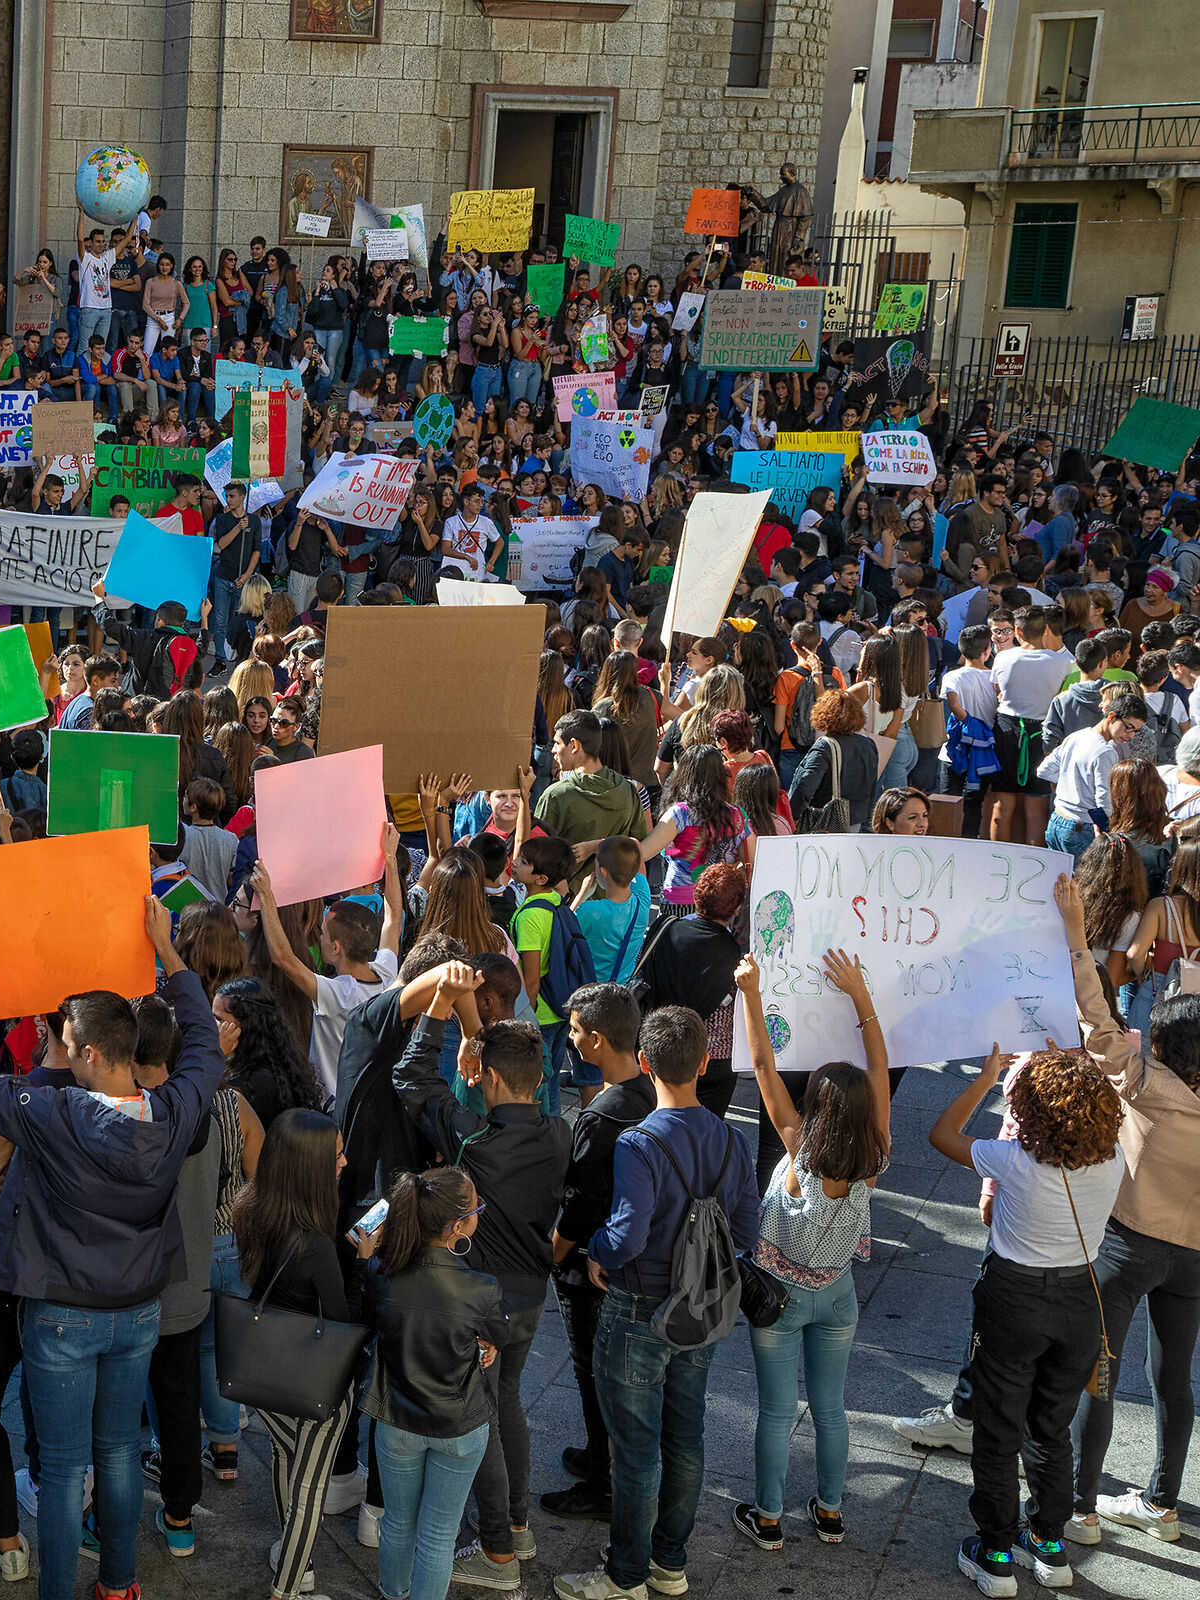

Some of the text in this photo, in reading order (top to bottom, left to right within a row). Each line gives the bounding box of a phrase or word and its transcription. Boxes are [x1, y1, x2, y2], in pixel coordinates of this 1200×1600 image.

[788, 291, 818, 302] MENTE
[827, 291, 846, 306] the
[787, 304, 818, 315] GENTE
[726, 318, 751, 328] NON
[707, 331, 799, 347] SPUDORATAMENTE
[705, 349, 793, 365] INDIFFERENTE
[857, 355, 887, 387] ACT
[22, 392, 36, 412] A
[597, 411, 615, 421] ACT
[594, 433, 612, 443] ECO
[864, 435, 879, 447] LA
[880, 434, 908, 446] TERRA
[595, 443, 610, 451] NOT
[868, 448, 892, 459] COME
[896, 448, 909, 460] LA
[169, 447, 200, 462] STA
[593, 451, 614, 463] EGO
[758, 452, 825, 472] SALTIAMO
[867, 461, 890, 473] CALDA
[95, 466, 178, 489] CAMBIAN
[750, 471, 823, 488] LE LEZIONI
[352, 501, 398, 524] OUT
